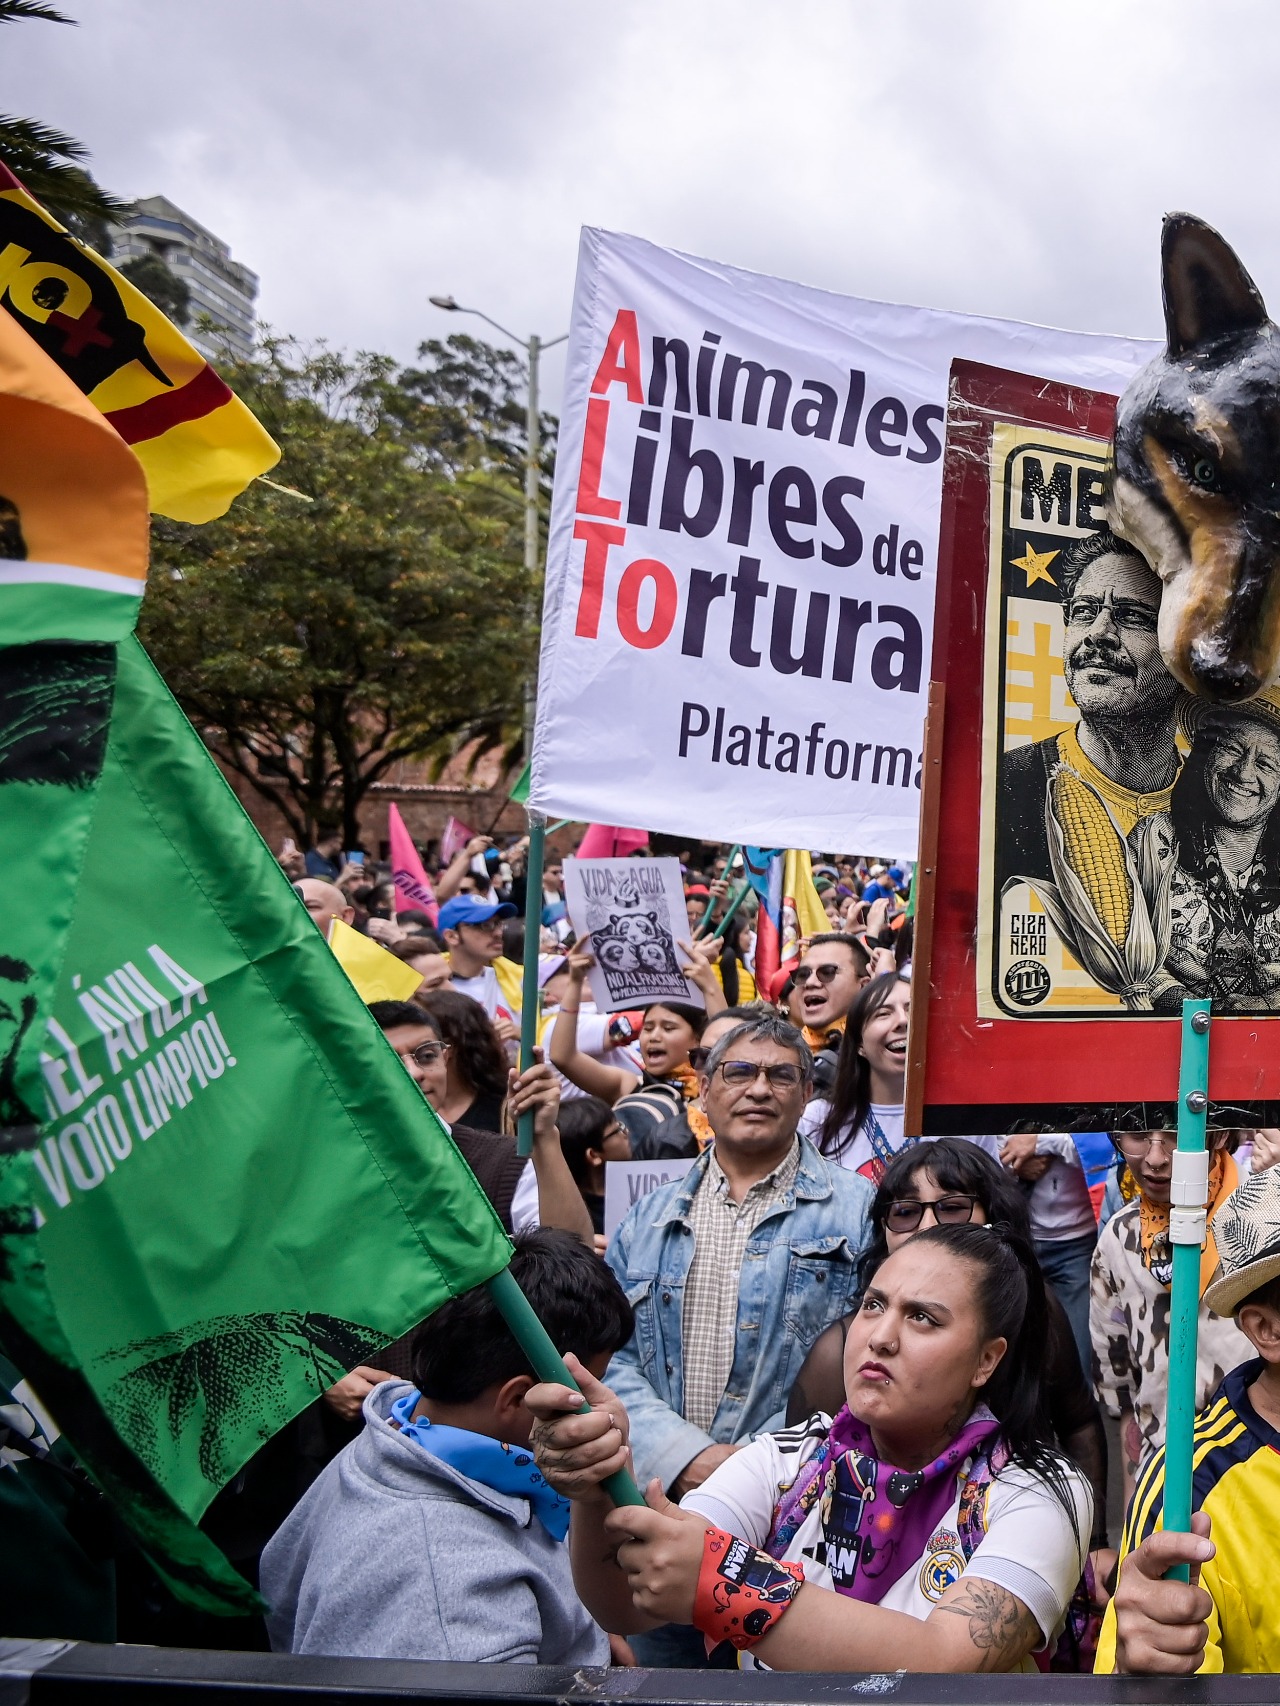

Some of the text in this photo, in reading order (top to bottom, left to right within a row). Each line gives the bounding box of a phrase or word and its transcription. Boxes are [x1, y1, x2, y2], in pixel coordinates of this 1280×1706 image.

[590, 309, 944, 464] Animales
[575, 398, 924, 581] Libres de
[573, 520, 923, 694] Tortura
[580, 866, 666, 898] VIDA AGUA
[72, 943, 208, 1075] ÁVILA
[606, 972, 685, 989] NO AL FRACKING
[33, 1011, 237, 1209] VOTO LIMPIO!
